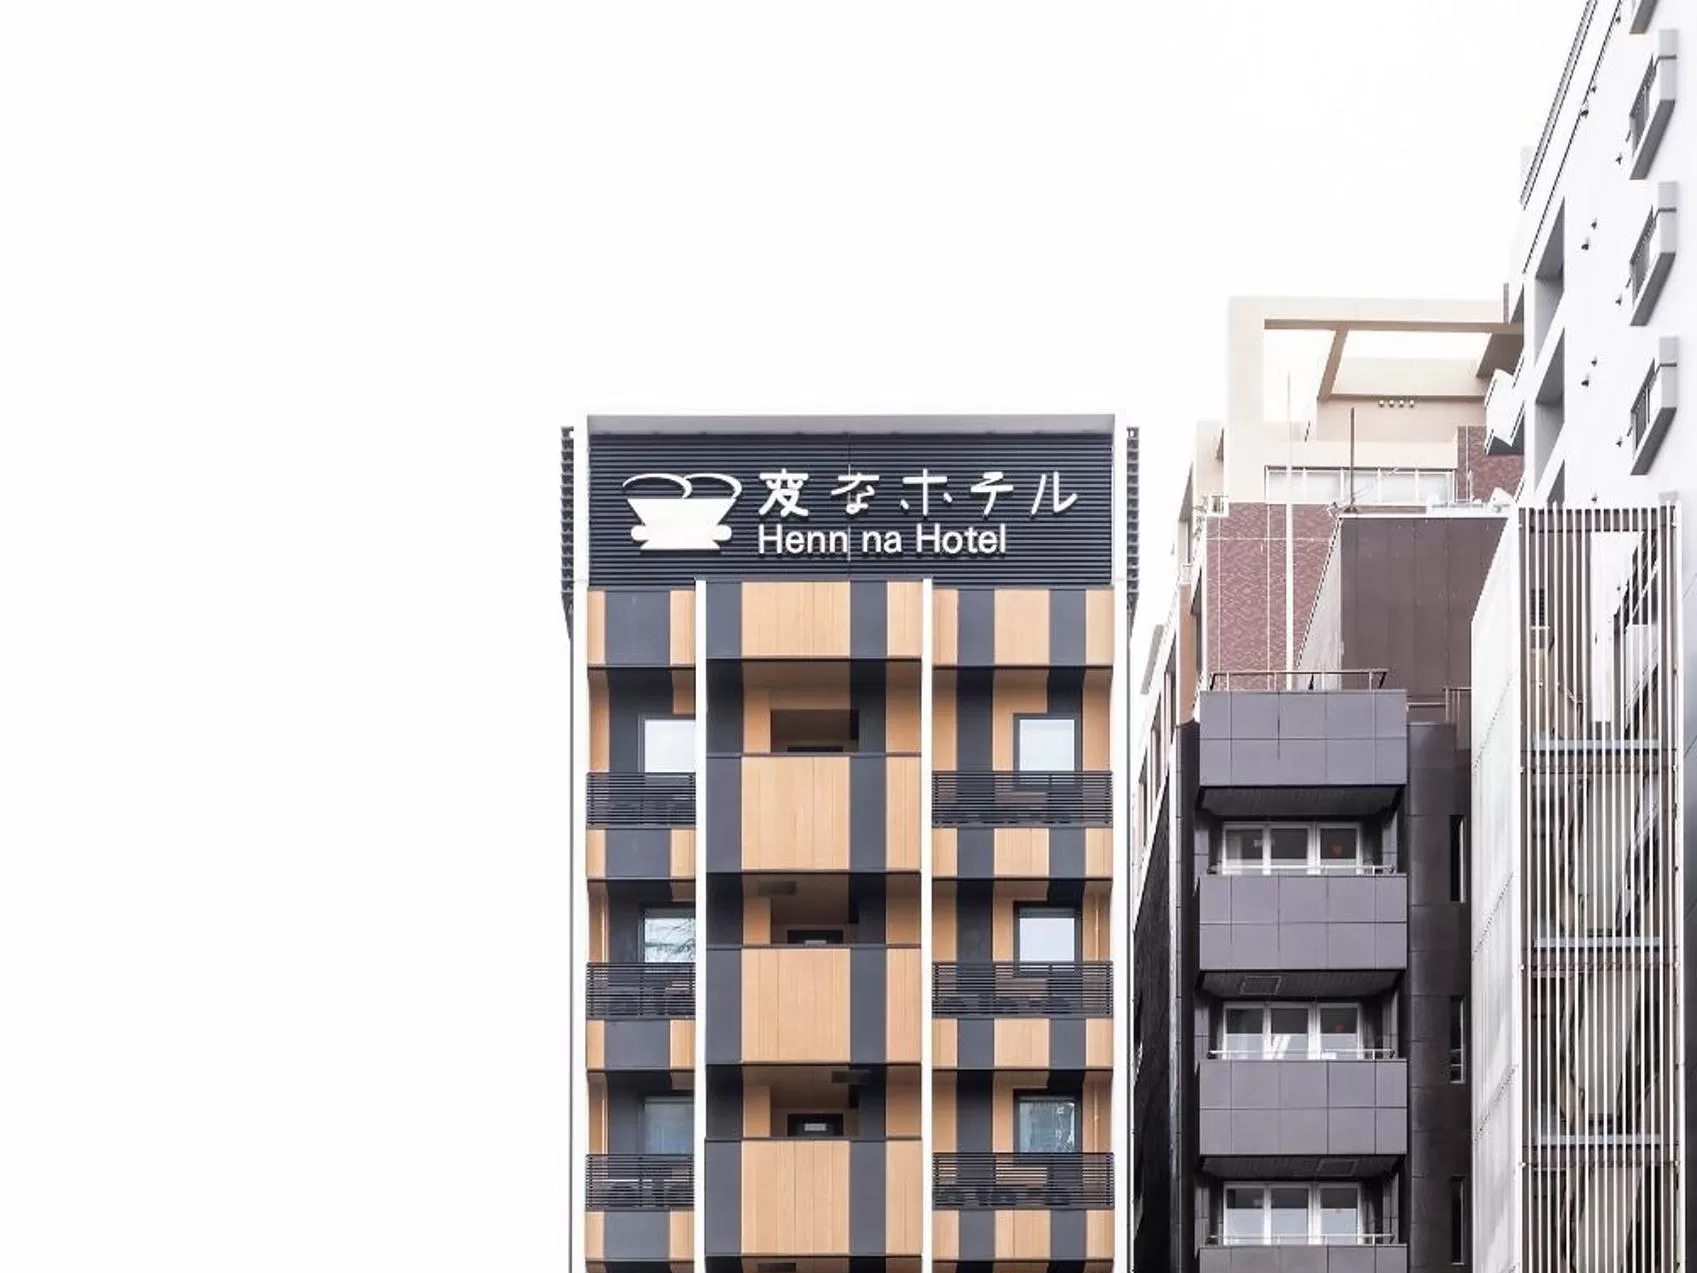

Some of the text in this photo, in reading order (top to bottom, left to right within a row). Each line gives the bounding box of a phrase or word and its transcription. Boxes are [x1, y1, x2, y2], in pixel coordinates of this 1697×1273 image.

[758, 467, 1078, 518] 変なホテル
[758, 523, 1008, 554] Henn na Hotel
